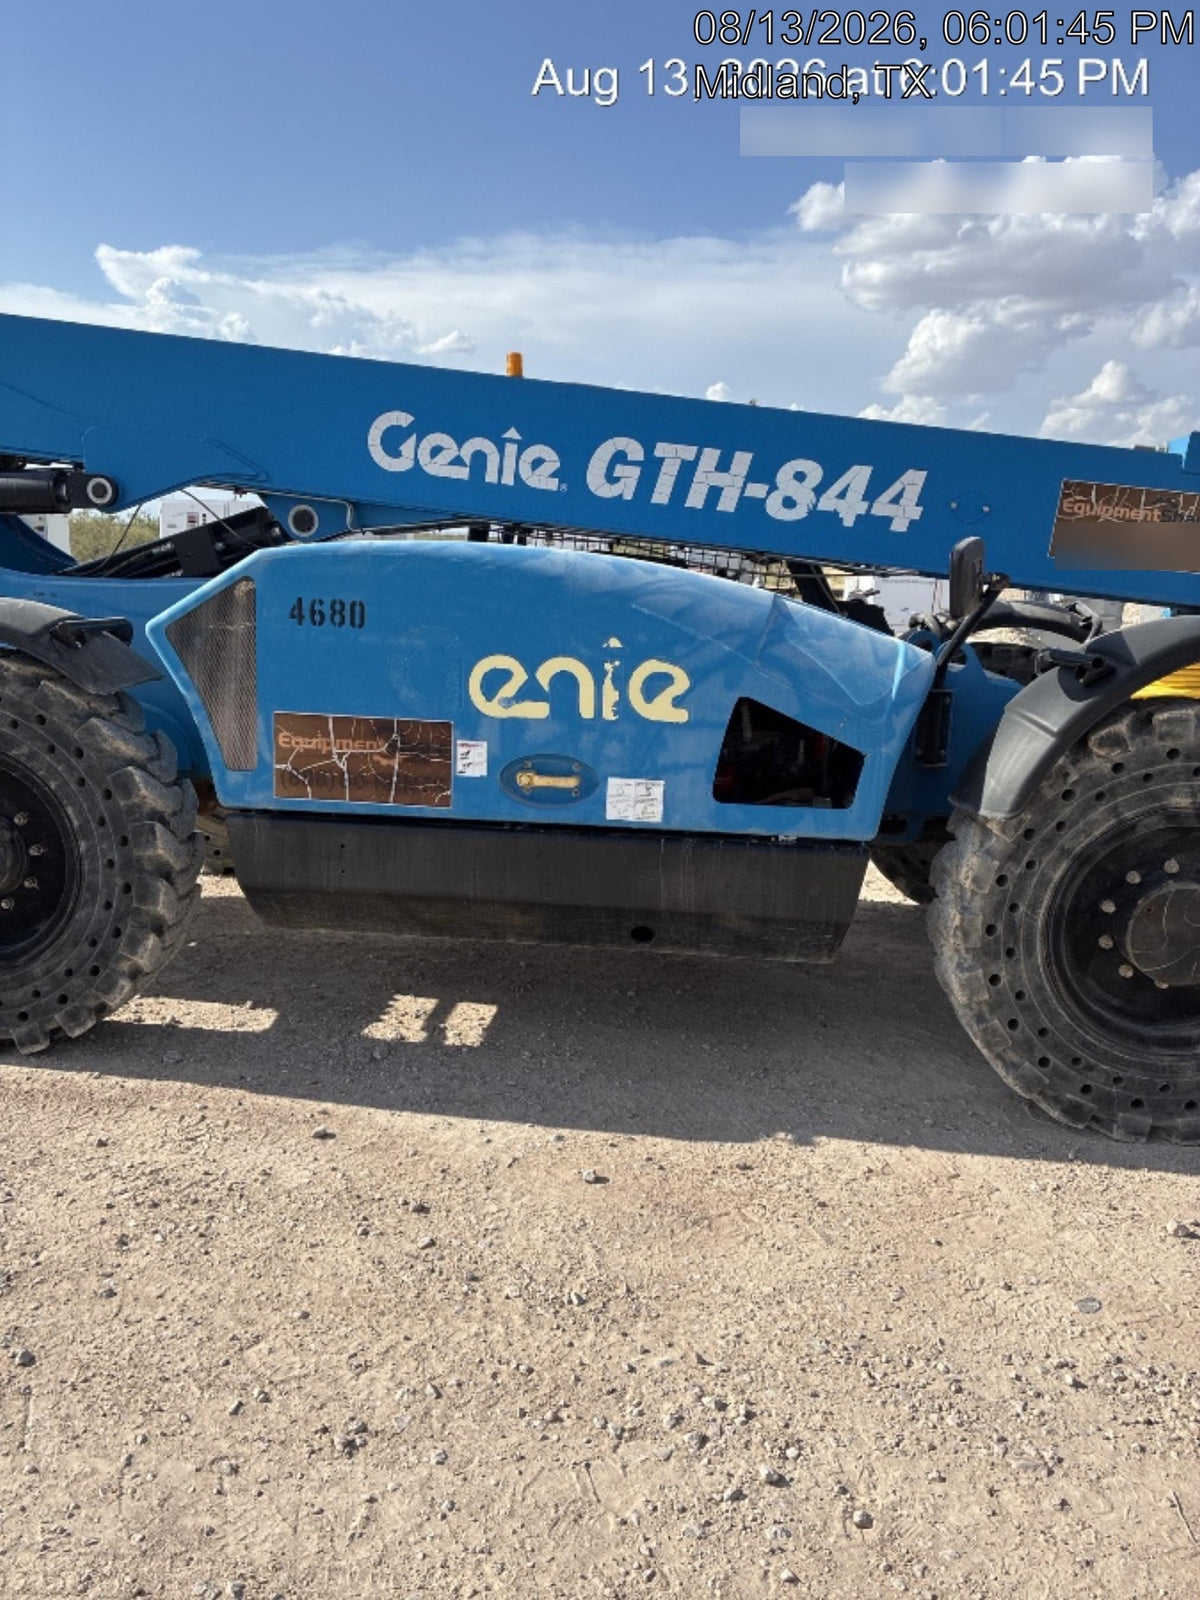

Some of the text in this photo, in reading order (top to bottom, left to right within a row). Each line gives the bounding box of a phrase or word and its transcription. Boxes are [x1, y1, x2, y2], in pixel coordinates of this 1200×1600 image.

[367, 410, 928, 533] Genie GTH-844
[289, 596, 366, 629] 4680
